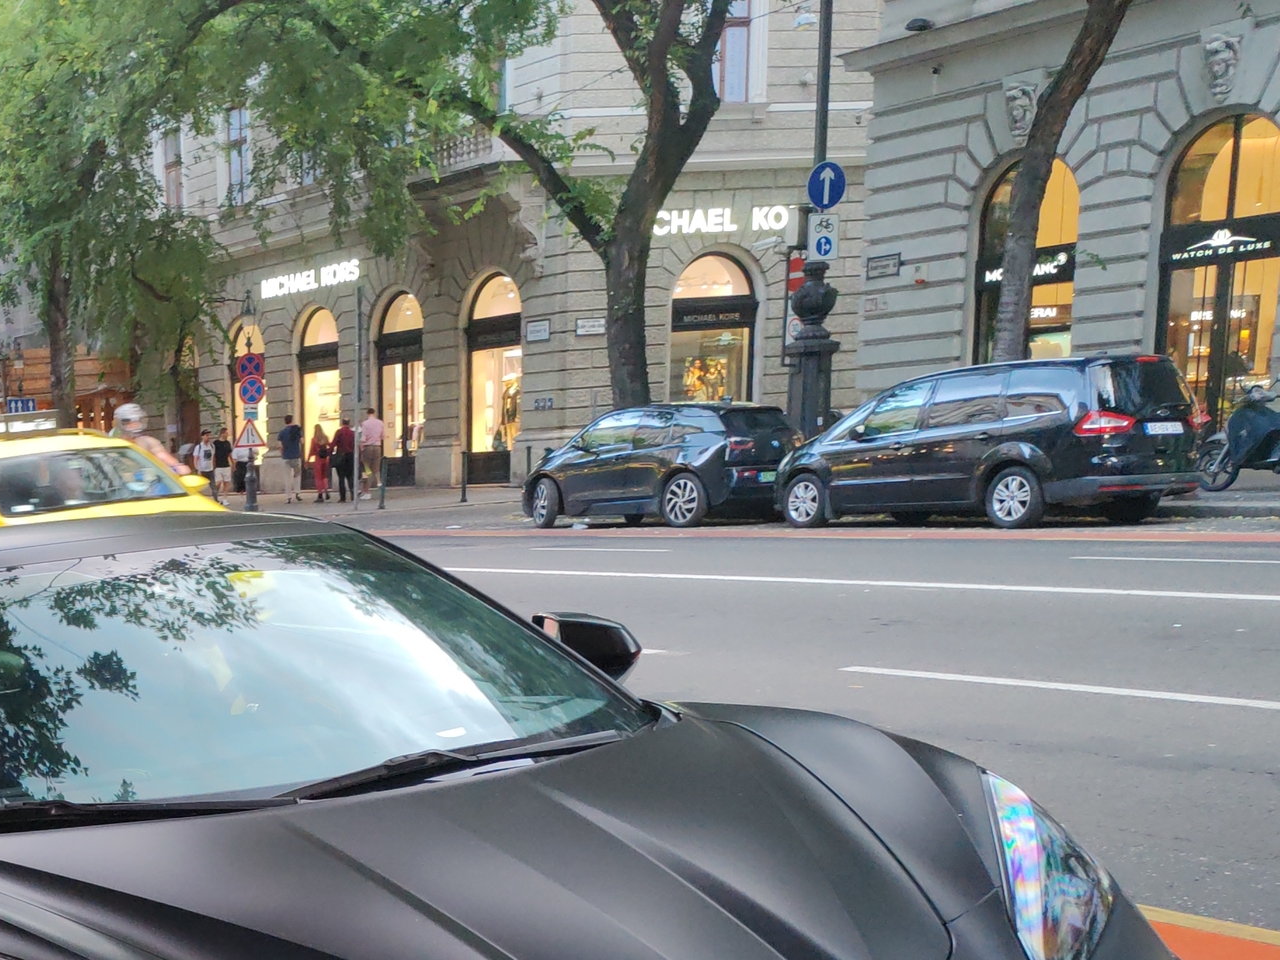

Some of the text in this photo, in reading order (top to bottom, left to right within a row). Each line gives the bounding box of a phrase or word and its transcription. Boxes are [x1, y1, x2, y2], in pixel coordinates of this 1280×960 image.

[653, 205, 789, 236] CHAEL KO
[1171, 241, 1272, 260] WATCH DE LUXE
[261, 258, 360, 300] MICHAEL KORS
